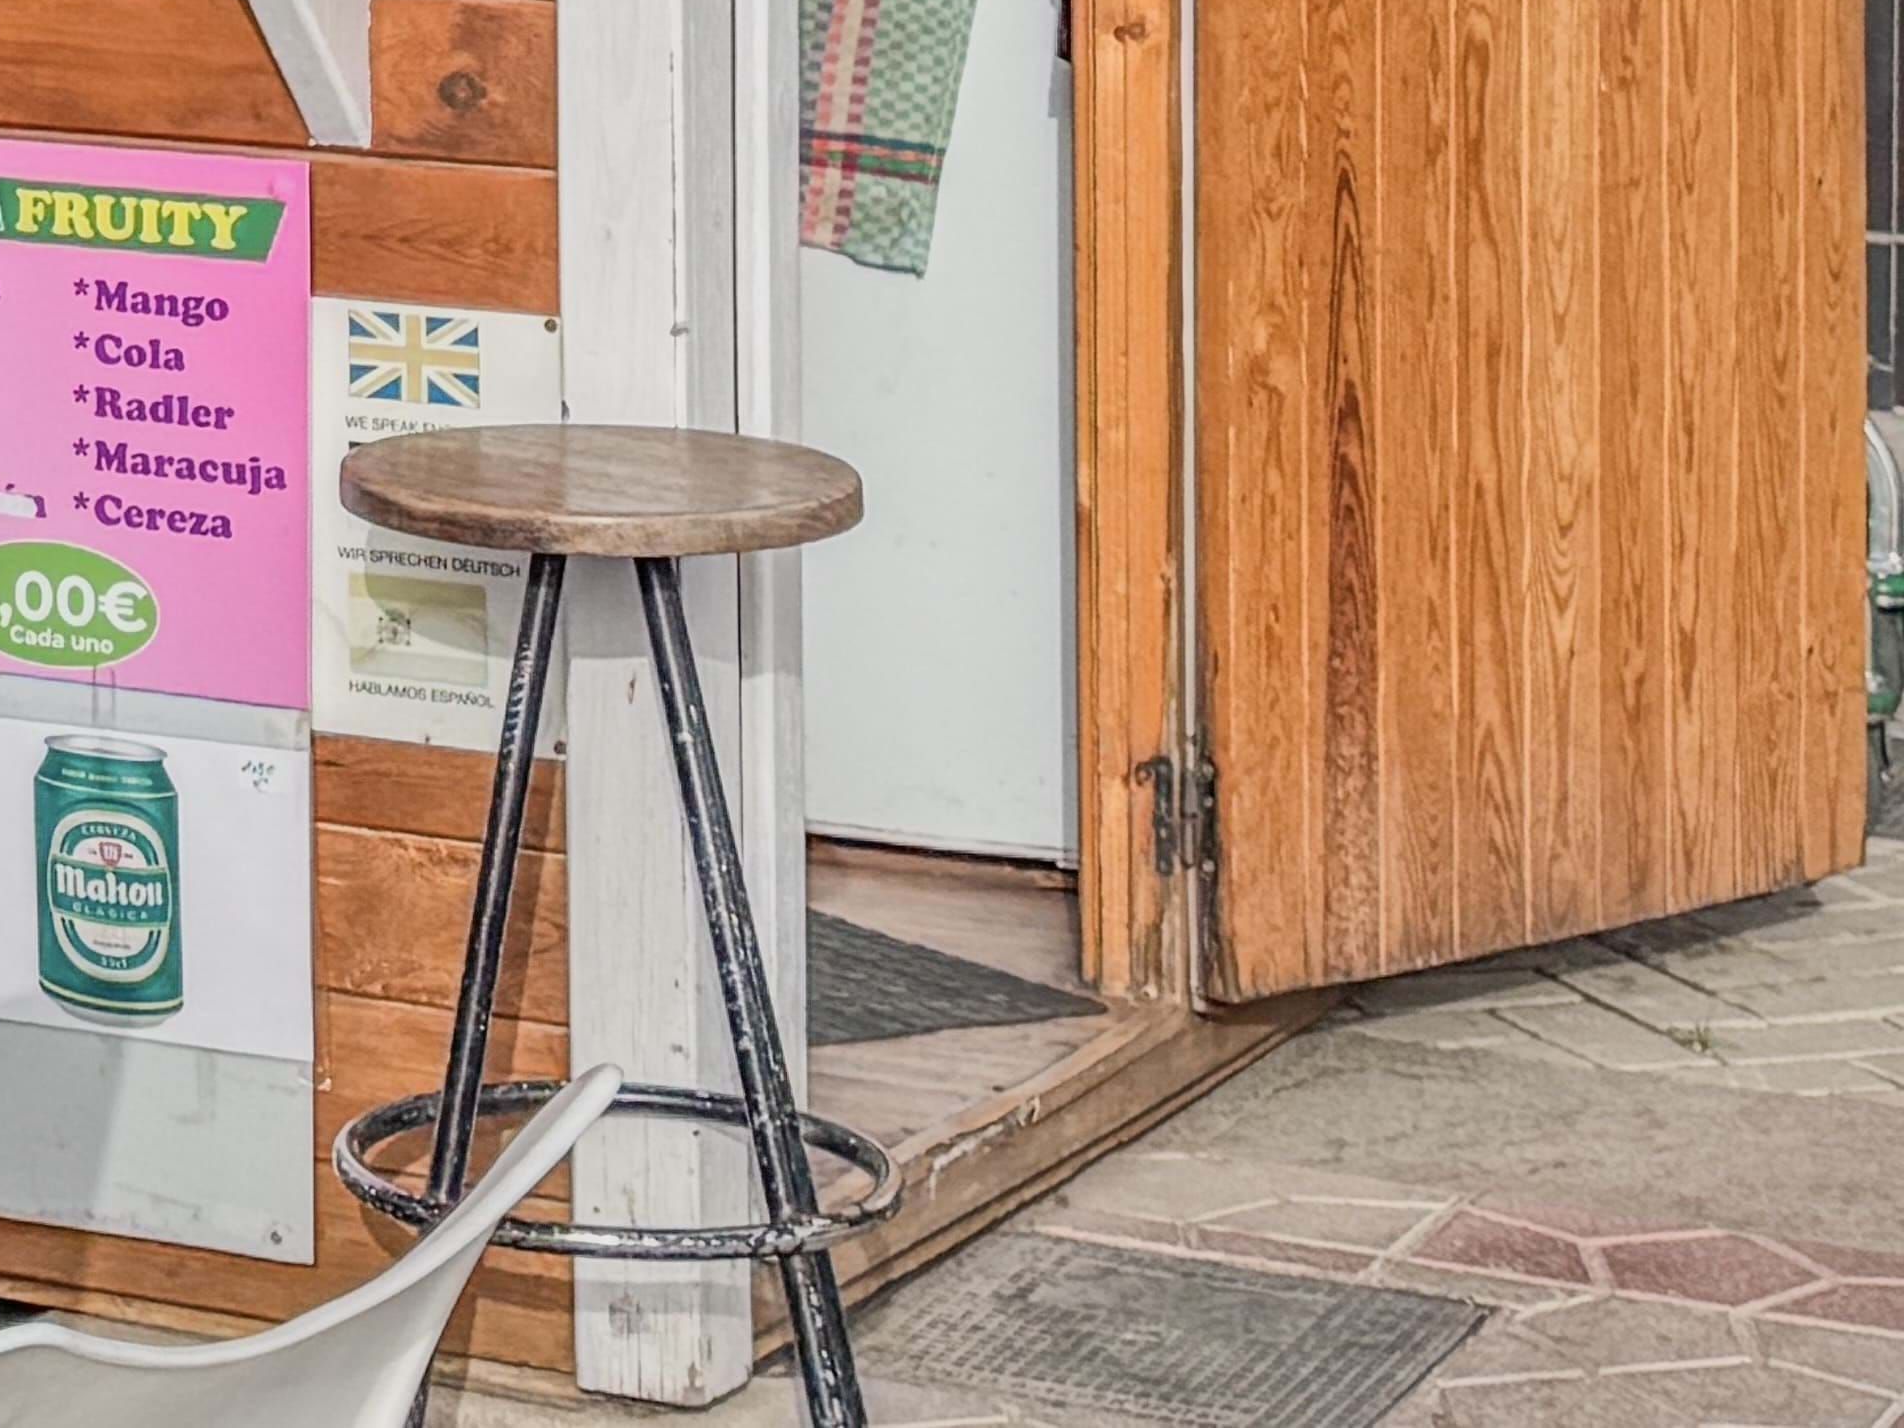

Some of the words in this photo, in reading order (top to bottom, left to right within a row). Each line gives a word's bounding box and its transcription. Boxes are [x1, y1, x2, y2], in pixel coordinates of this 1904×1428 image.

[14, 187, 249, 252] FRUITY
[93, 278, 231, 328] Mango
[92, 332, 186, 373] Cola
[92, 385, 236, 432] Radler
[344, 415, 368, 431] WE
[92, 439, 288, 494] Maracuja
[92, 493, 234, 541] Cereza
[337, 546, 367, 563] WIR
[369, 551, 449, 571] SPRECHEN
[451, 559, 521, 577] DEUTSCH
[9, 624, 66, 652] Cada
[68, 630, 115, 658] uno
[348, 680, 427, 702] HABLAMOS
